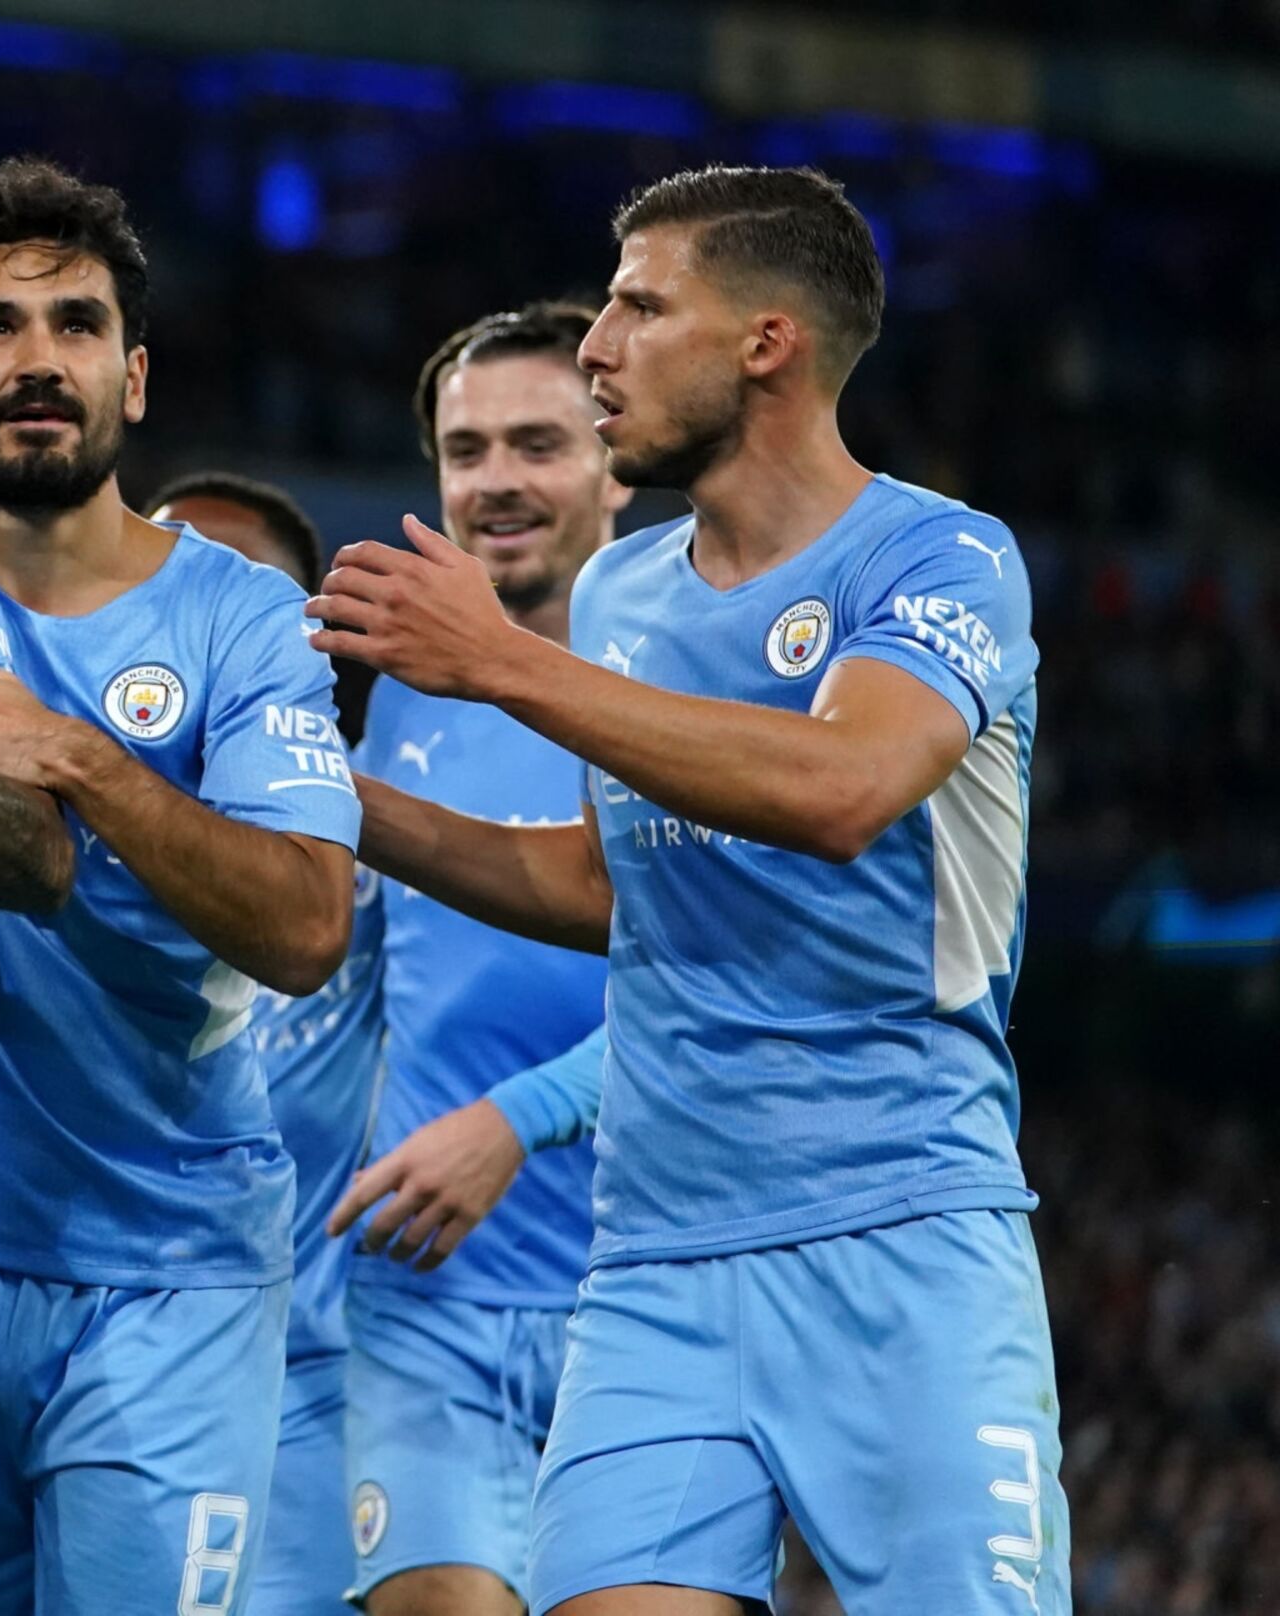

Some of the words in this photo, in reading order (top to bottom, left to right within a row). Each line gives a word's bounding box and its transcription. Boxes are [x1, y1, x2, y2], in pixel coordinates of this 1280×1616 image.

[775, 602, 828, 632] MANCHESTER
[894, 595, 1001, 672] NEXEN
[786, 664, 808, 675] CITY
[910, 619, 989, 687] TIRE
[114, 669, 180, 694] MANCHESTER
[128, 726, 154, 736] CITY
[977, 1425, 1043, 1562] 3
[177, 1491, 249, 1616] 8
